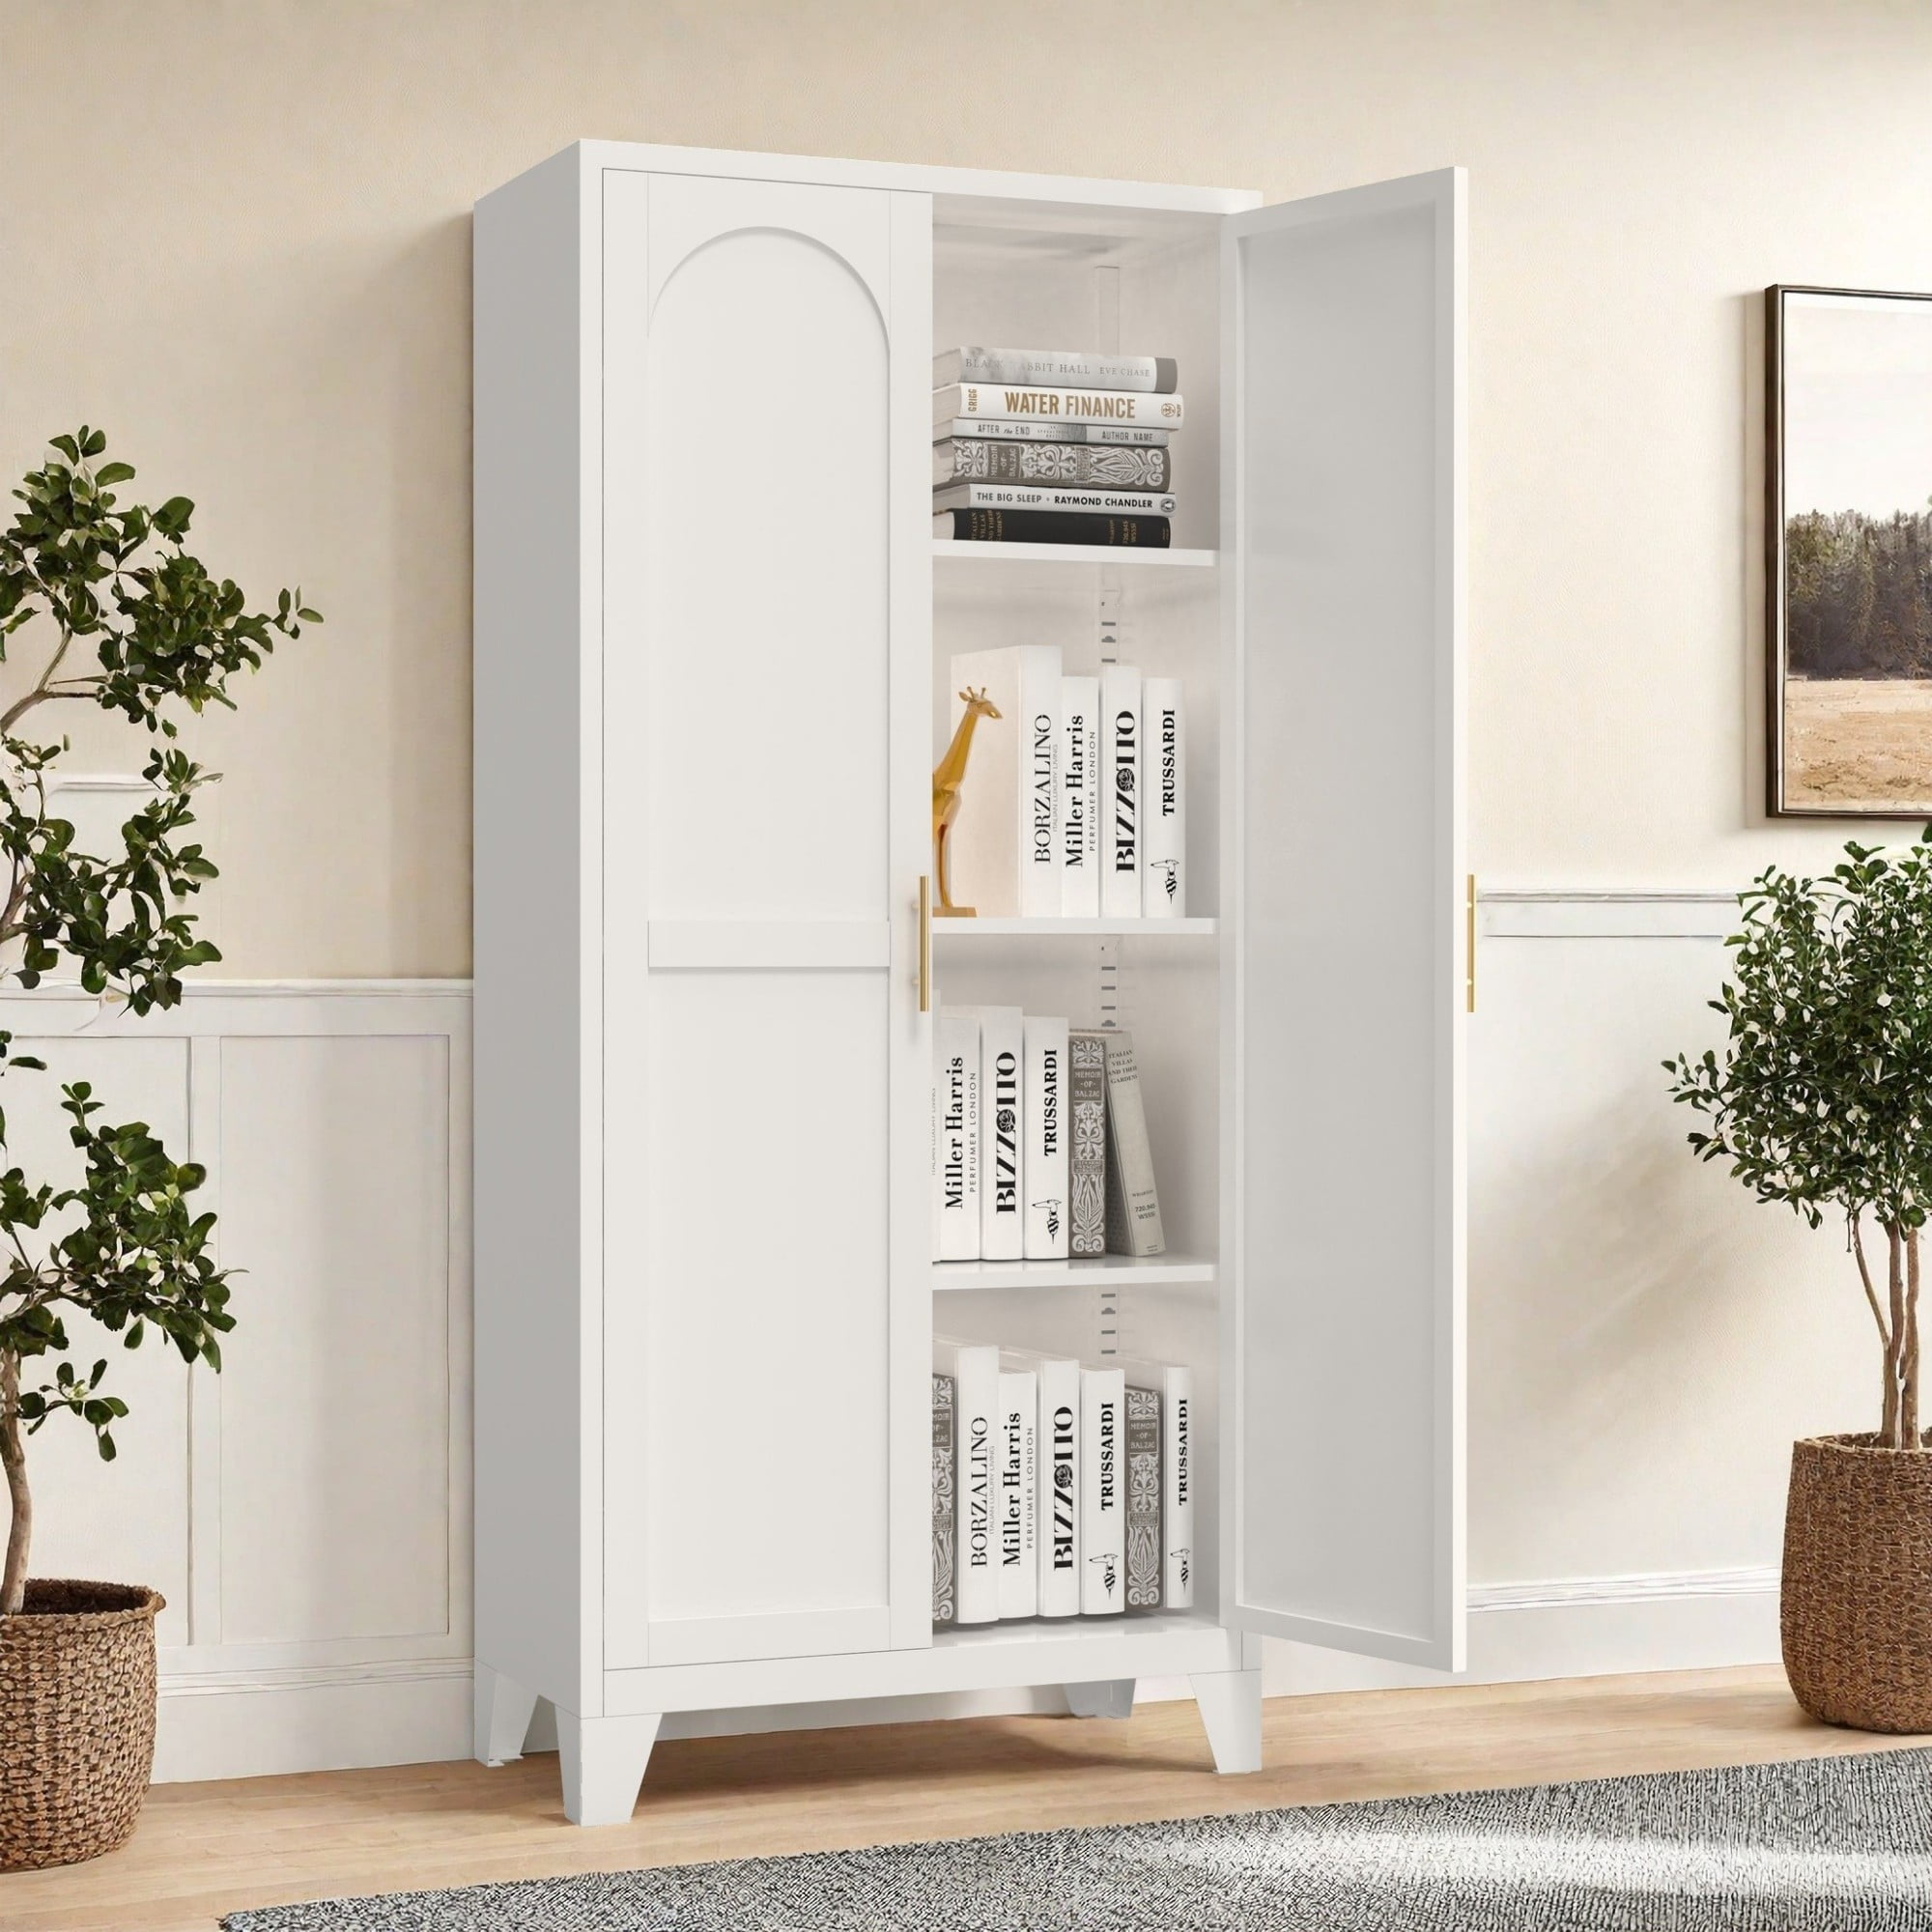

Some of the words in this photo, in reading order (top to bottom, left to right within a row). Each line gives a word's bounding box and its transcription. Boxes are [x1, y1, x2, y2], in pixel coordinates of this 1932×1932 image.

[968, 388, 978, 412] GRIGG
[1005, 391, 1060, 415] WATER
[1065, 396, 1136, 419] FINANCE
[1059, 363, 1091, 375] HALL
[1099, 366, 1117, 375] EVE
[1121, 368, 1151, 378] CHASE
[978, 424, 1000, 434] AFTER
[1015, 426, 1031, 436] END
[1101, 431, 1129, 440] AUTHOR
[1133, 432, 1153, 442] NAME
[977, 492, 994, 501] THE
[997, 493, 1013, 502] BIG
[1016, 494, 1042, 503] SLEEP
[1054, 495, 1102, 507] RAYMOND
[1105, 497, 1153, 509] CHANDLER
[1034, 714, 1051, 864] BORZALINO
[1065, 715, 1083, 790] Harris
[1162, 709, 1176, 816] TRUSSARDI
[1065, 795, 1083, 867] Miller
[945, 1057, 963, 1132] Harris
[1044, 1049, 1058, 1156] TRUSSARDI
[945, 1137, 963, 1209] Miller
[932, 1412, 950, 1421] MOIR
[1003, 1412, 1021, 1488] Harris
[1179, 1399, 1187, 1506] TRUSSARDI
[971, 1416, 988, 1568] BORZALINO
[1100, 1403, 1114, 1511] TRUSSARDI
[1003, 1494, 1021, 1567] Miller
